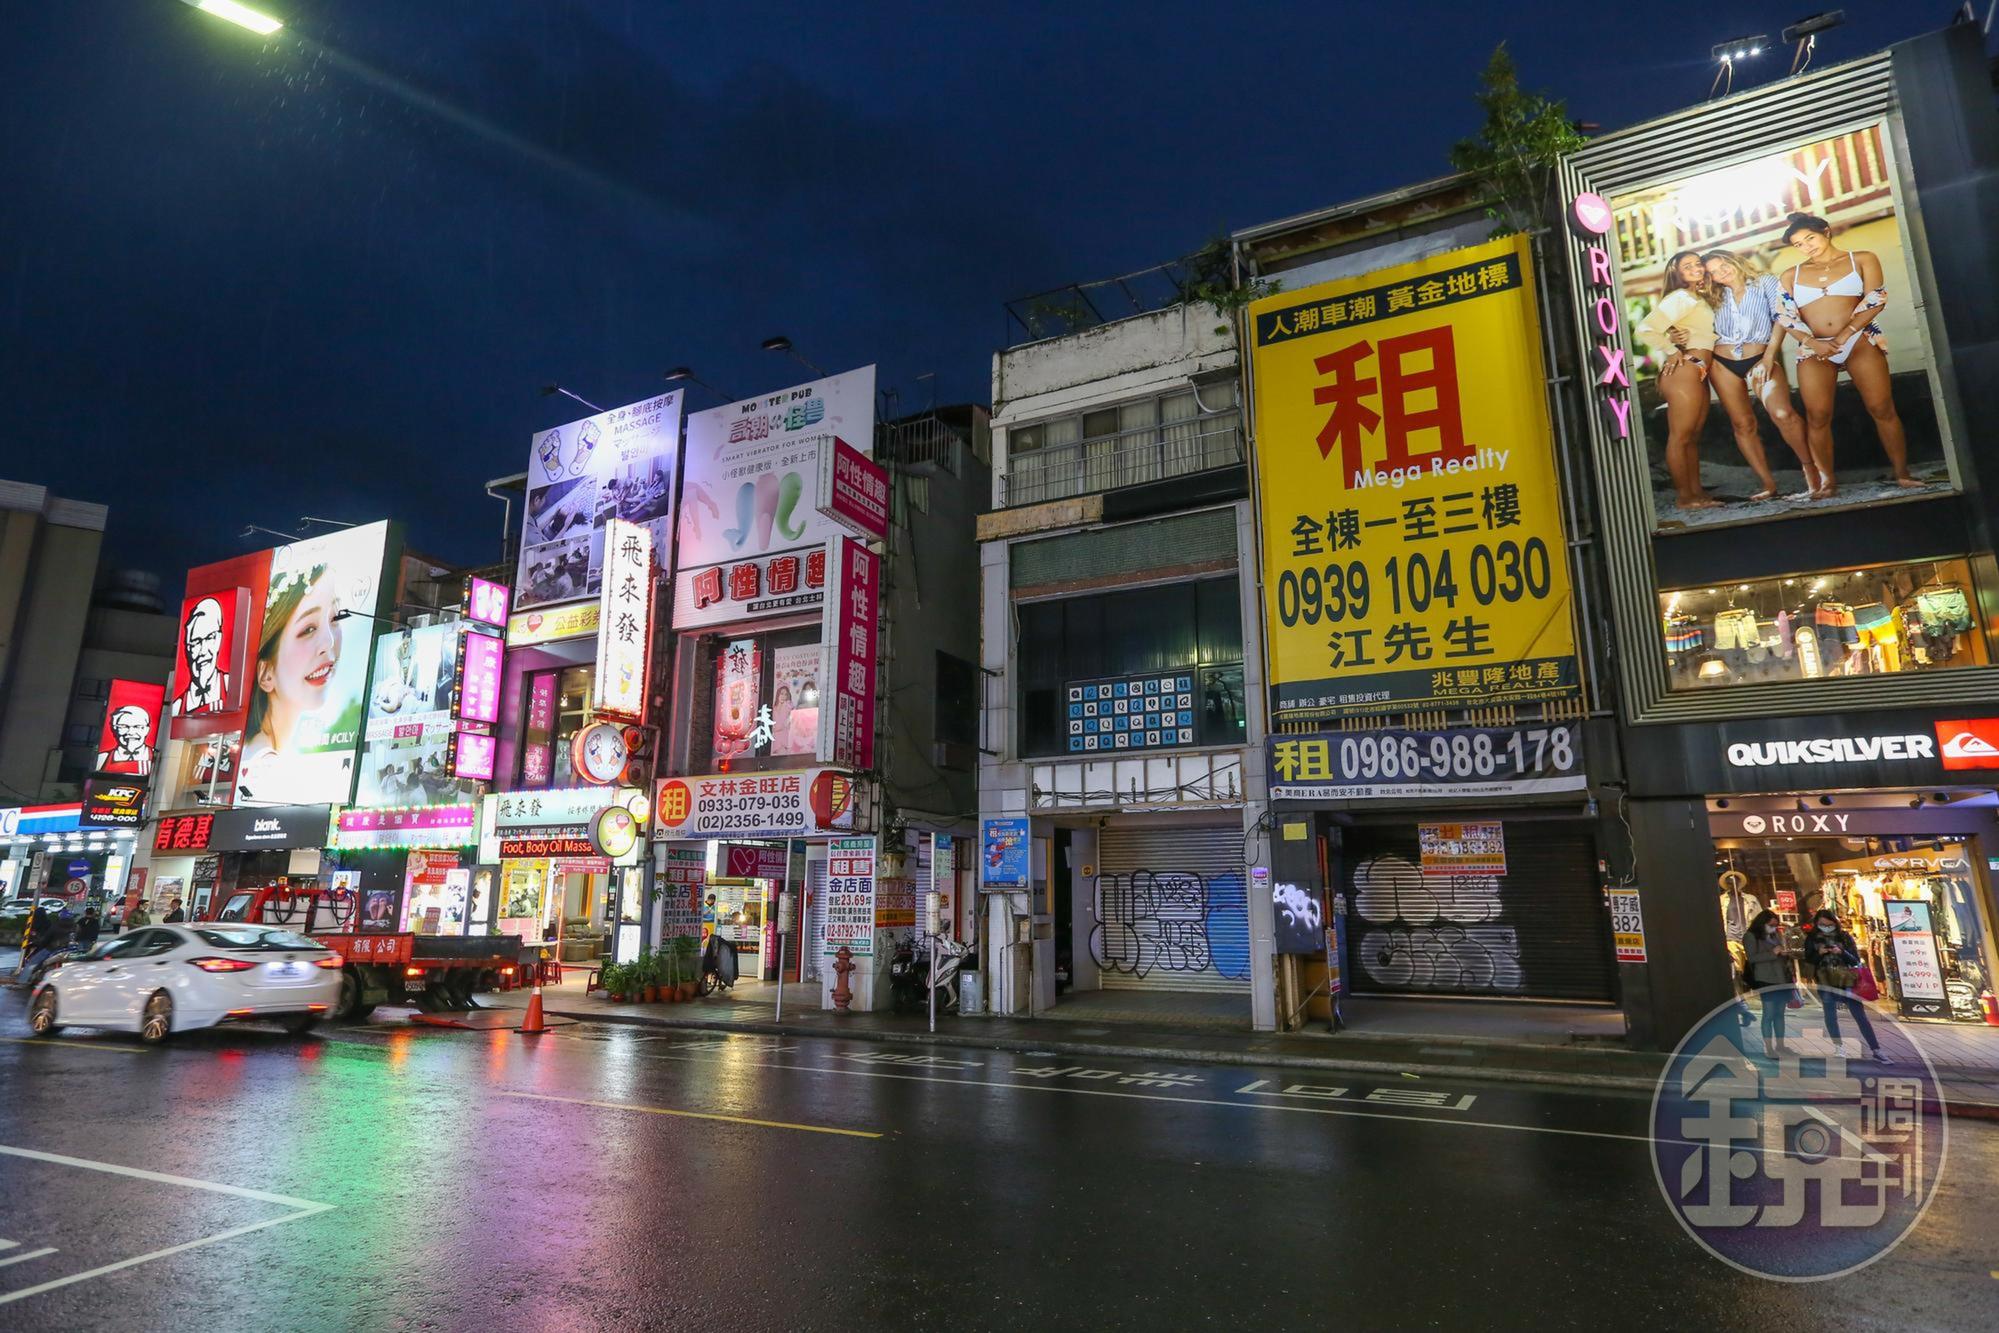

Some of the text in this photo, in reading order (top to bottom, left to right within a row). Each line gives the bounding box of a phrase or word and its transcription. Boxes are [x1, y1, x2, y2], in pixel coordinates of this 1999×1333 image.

[1268, 261, 1509, 341] 人潮車潮 黃金地標
[1590, 245, 1629, 439] ROXY
[791, 387, 813, 401] PUB
[1312, 324, 1477, 490] 租
[614, 412, 662, 435] MASSAGE
[783, 441, 796, 449] FOR
[836, 452, 886, 504] 阿性情趣
[1353, 446, 1510, 491] Mega Realty
[1290, 483, 1522, 557] 全棟一至三樓
[614, 535, 644, 645] 飛來發
[1277, 536, 1550, 628] 0939 104 030
[848, 548, 871, 696] 阿性情趣
[1327, 614, 1496, 669] 江先生
[1432, 662, 1560, 688] 兆豐隆地產
[1433, 679, 1560, 696] MEGA REALTY
[1273, 727, 1575, 782] 租 0986-988-178
[1727, 734, 1936, 767] QUIKSILVER
[108, 788, 136, 798] KFC
[700, 776, 801, 798] 文林金旺店
[499, 798, 543, 818] 飛來發
[662, 787, 687, 821] 租
[699, 794, 800, 813] 0933-079-036
[155, 813, 214, 849] 肯德基
[697, 811, 805, 832] (02)2356-1499
[1772, 814, 1849, 834] ROXY
[503, 839, 597, 856] Foot, Body Oil Massa
[758, 850, 787, 864] 阿性情
[832, 860, 870, 875] 租售
[829, 877, 872, 893] 金店面
[827, 924, 872, 938] 02-8792-7171
[1613, 915, 1641, 932] 382
[353, 938, 398, 954] 有限 公司
